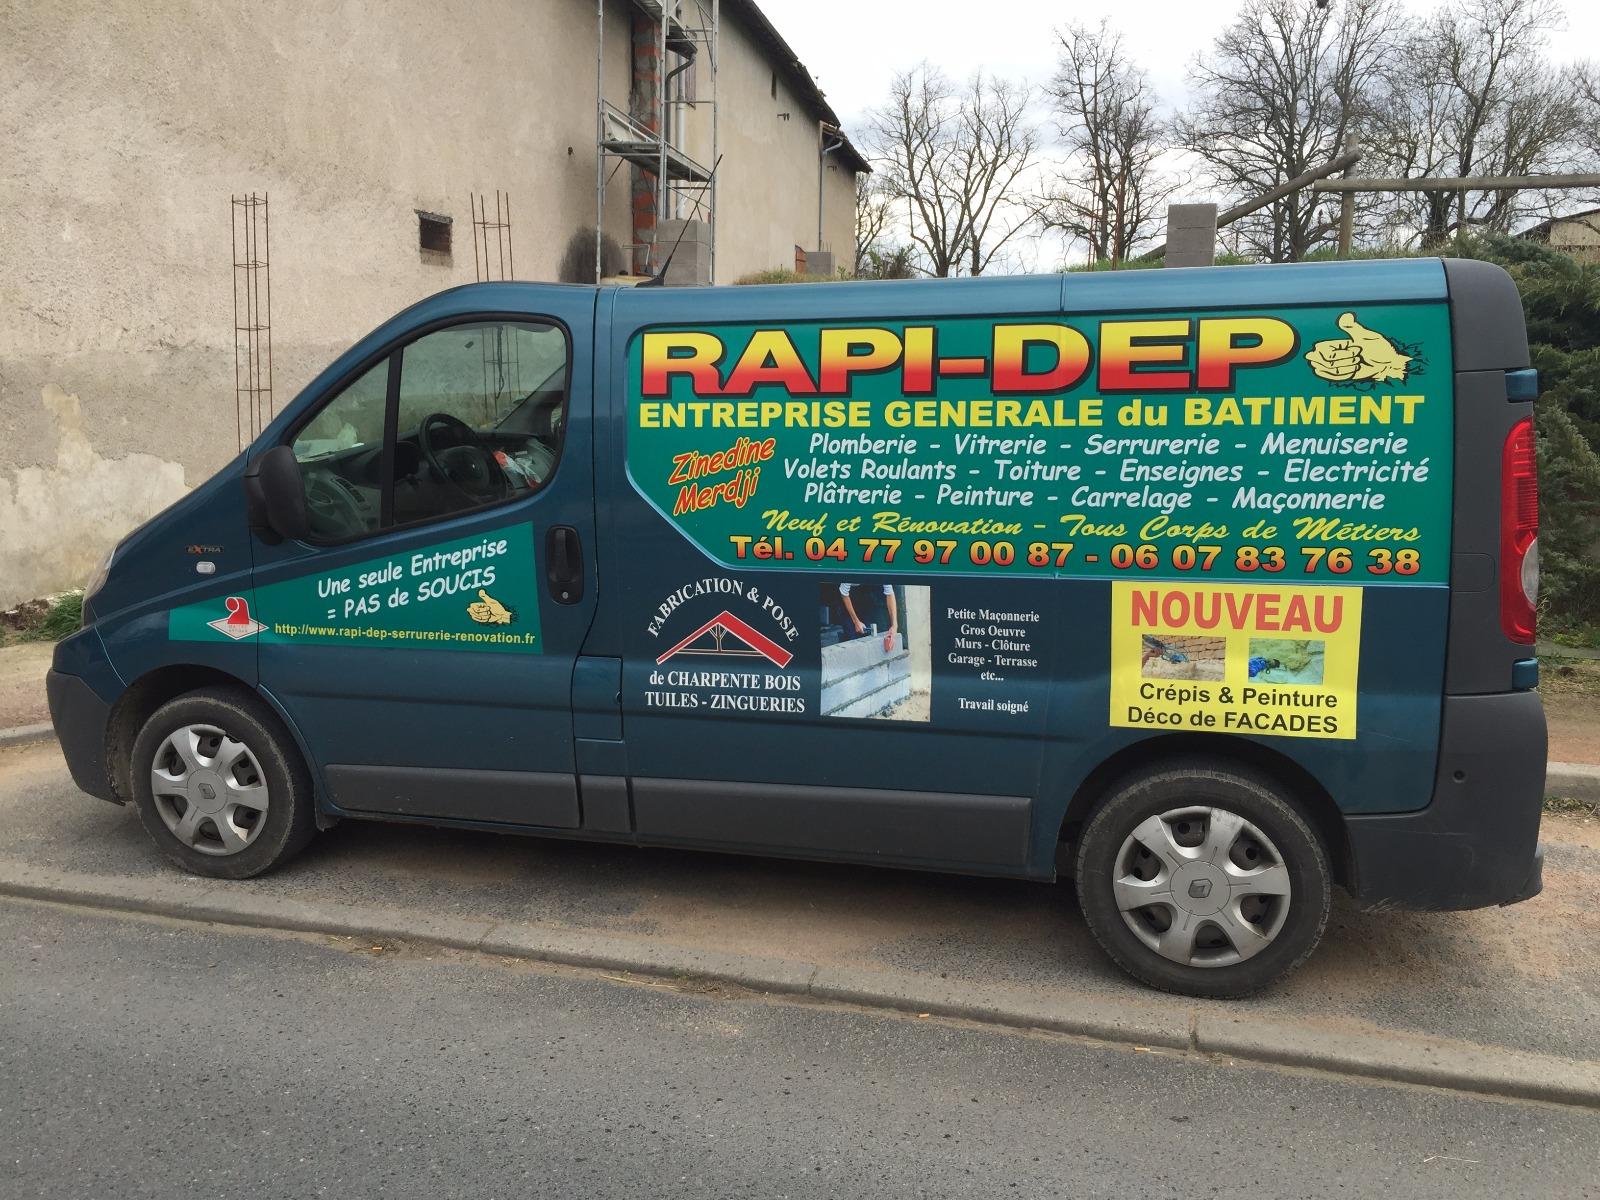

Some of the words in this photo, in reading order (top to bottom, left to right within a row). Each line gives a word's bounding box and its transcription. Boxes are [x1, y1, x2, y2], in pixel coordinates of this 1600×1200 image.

[641, 317, 1299, 397] RAPI-DEP
[639, 402, 870, 428] ENTREPRISE
[884, 400, 1103, 427] GENERALE
[1118, 400, 1167, 426] du
[1184, 396, 1424, 426] BATIMENT
[809, 432, 917, 454] Plomberie
[955, 433, 1047, 454] Vitrerie
[1084, 433, 1220, 455] Serrurerie
[1260, 432, 1408, 454] Menuiserie
[668, 437, 776, 485] Zinedine
[784, 458, 851, 479] Volets
[860, 458, 957, 480] Roulants
[994, 459, 1081, 481] Toiture
[1119, 458, 1243, 488] Enseignes
[1284, 457, 1430, 483] Electricité
[673, 467, 760, 516] Merdji
[804, 481, 901, 504] Plâtrerie
[936, 484, 1034, 506] Peinture
[1071, 485, 1192, 514] Carrelage
[1232, 486, 1386, 514] Maçonnerie
[762, 509, 828, 536] Neuf
[836, 516, 862, 532] et
[872, 512, 1023, 536] Rénovation
[1060, 514, 1128, 537] Tous
[1139, 514, 1230, 543] Corps
[1242, 520, 1278, 540] de
[1293, 516, 1422, 542] Métiers
[187, 545, 222, 554] EXTRA
[729, 535, 794, 560] Tél.
[804, 536, 848, 562] 04
[858, 538, 902, 563] 77
[912, 539, 958, 565] 97
[969, 540, 1016, 566] 00
[1027, 542, 1074, 567] 87
[1110, 543, 1160, 570] 06
[1172, 544, 1222, 571] 07
[1234, 545, 1287, 573] 83
[1300, 546, 1353, 574] 76
[1366, 547, 1421, 575] 38
[318, 577, 350, 598] Une
[358, 561, 403, 589] seule
[411, 539, 508, 577] Entreprise
[327, 609, 336, 619] =
[344, 594, 381, 619] PAS
[388, 587, 410, 608] de
[417, 566, 497, 602] SOUCIS
[648, 578, 743, 638] FABRICATION
[747, 586, 759, 603] &
[762, 596, 799, 642] POSE
[947, 607, 976, 620] Petite
[979, 609, 1040, 623] Maçonnerie
[1131, 590, 1343, 633] NOUVEAU
[275, 623, 535, 644] http://www.rapi-dep-serrurerie-renovation.fr
[955, 638, 982, 649] Murs
[992, 639, 1031, 651] Clôture
[960, 624, 986, 636] Gros
[988, 625, 1026, 637] Oeuvre
[948, 652, 985, 667] Garage
[994, 654, 1038, 667] Terrasse
[650, 671, 665, 685] de
[667, 671, 760, 689] CHARPENTE
[764, 675, 800, 691] BOIS
[980, 670, 1004, 681] etc...
[645, 692, 698, 707] TUILES
[711, 694, 805, 713] ZINGUERIES
[958, 698, 994, 710] Travail
[997, 700, 1029, 714] soigné
[1139, 682, 1211, 705] Crépis
[1218, 687, 1234, 704] &
[1242, 688, 1338, 708] Peinture
[1128, 706, 1183, 725] Déco
[1190, 710, 1216, 727] de
[1224, 712, 1338, 734] FACADES
